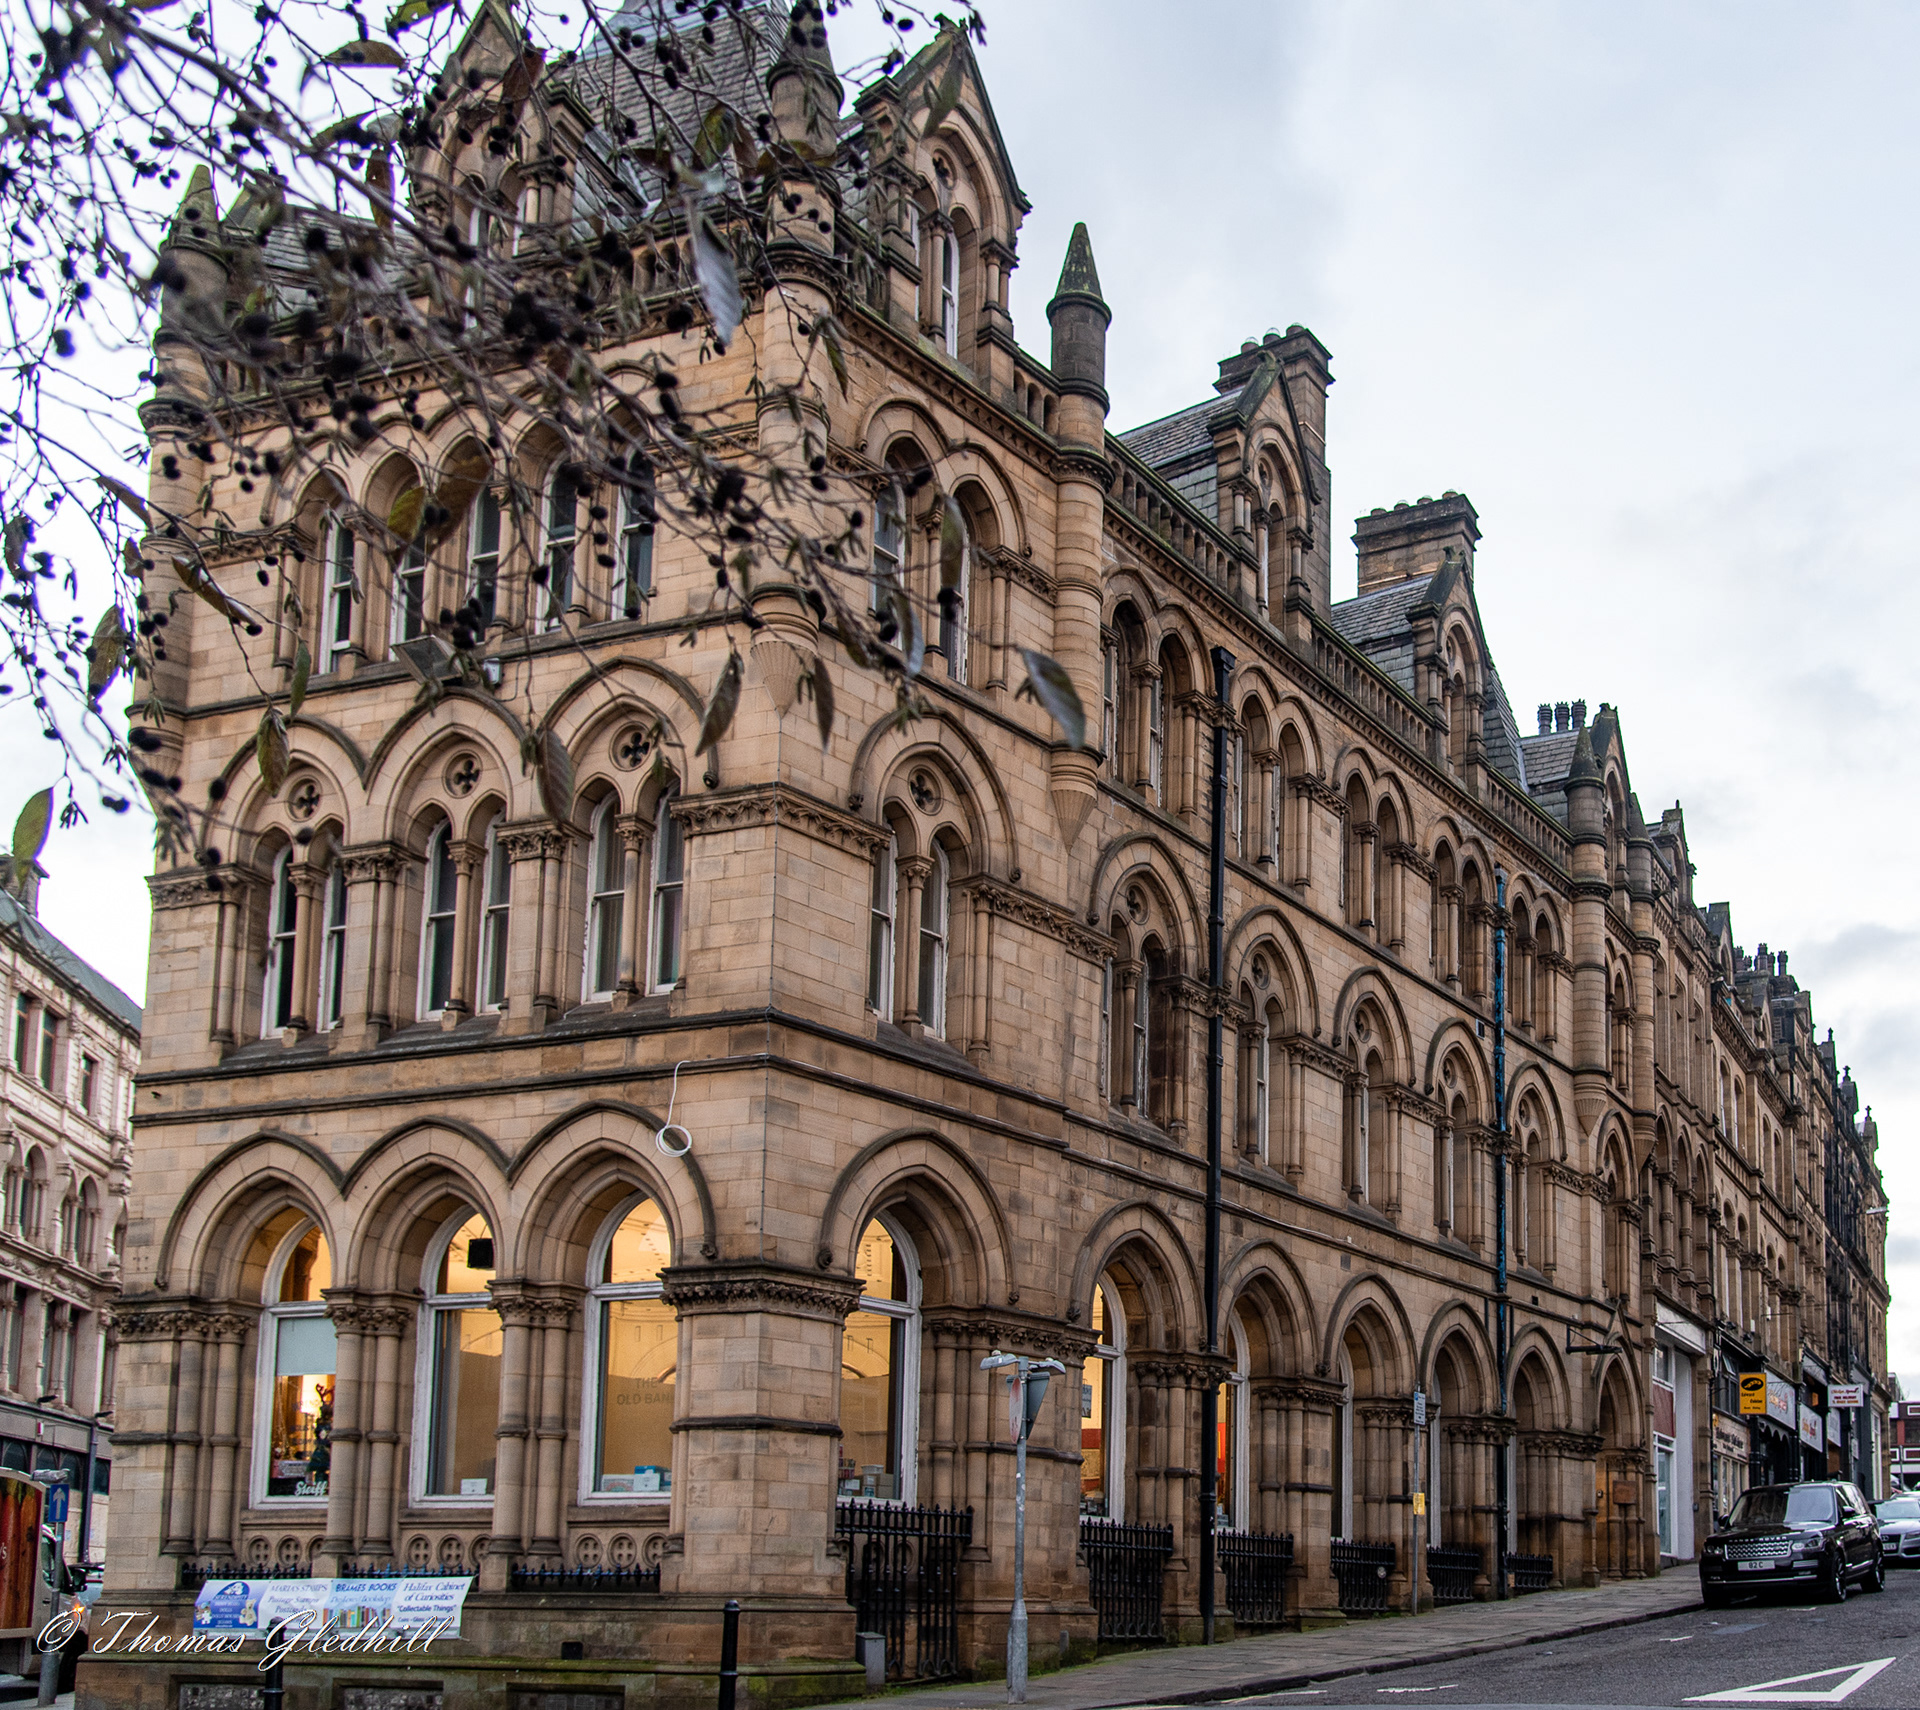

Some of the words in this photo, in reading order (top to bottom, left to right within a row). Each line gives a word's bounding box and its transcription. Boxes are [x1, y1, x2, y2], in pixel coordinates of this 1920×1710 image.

[616, 1393, 642, 1406] OLD
[644, 1392, 675, 1405] BAN
[294, 1480, 328, 1496] Steiff
[300, 1583, 328, 1592] STAMPS
[368, 1582, 397, 1592] BOOKS
[403, 1581, 432, 1592] Halifax
[435, 1580, 466, 1591] Cabinet
[404, 1592, 413, 1602] of
[415, 1592, 455, 1601] Curiosities
[397, 1604, 432, 1613] "Collectable
[432, 1604, 457, 1614] Things"
